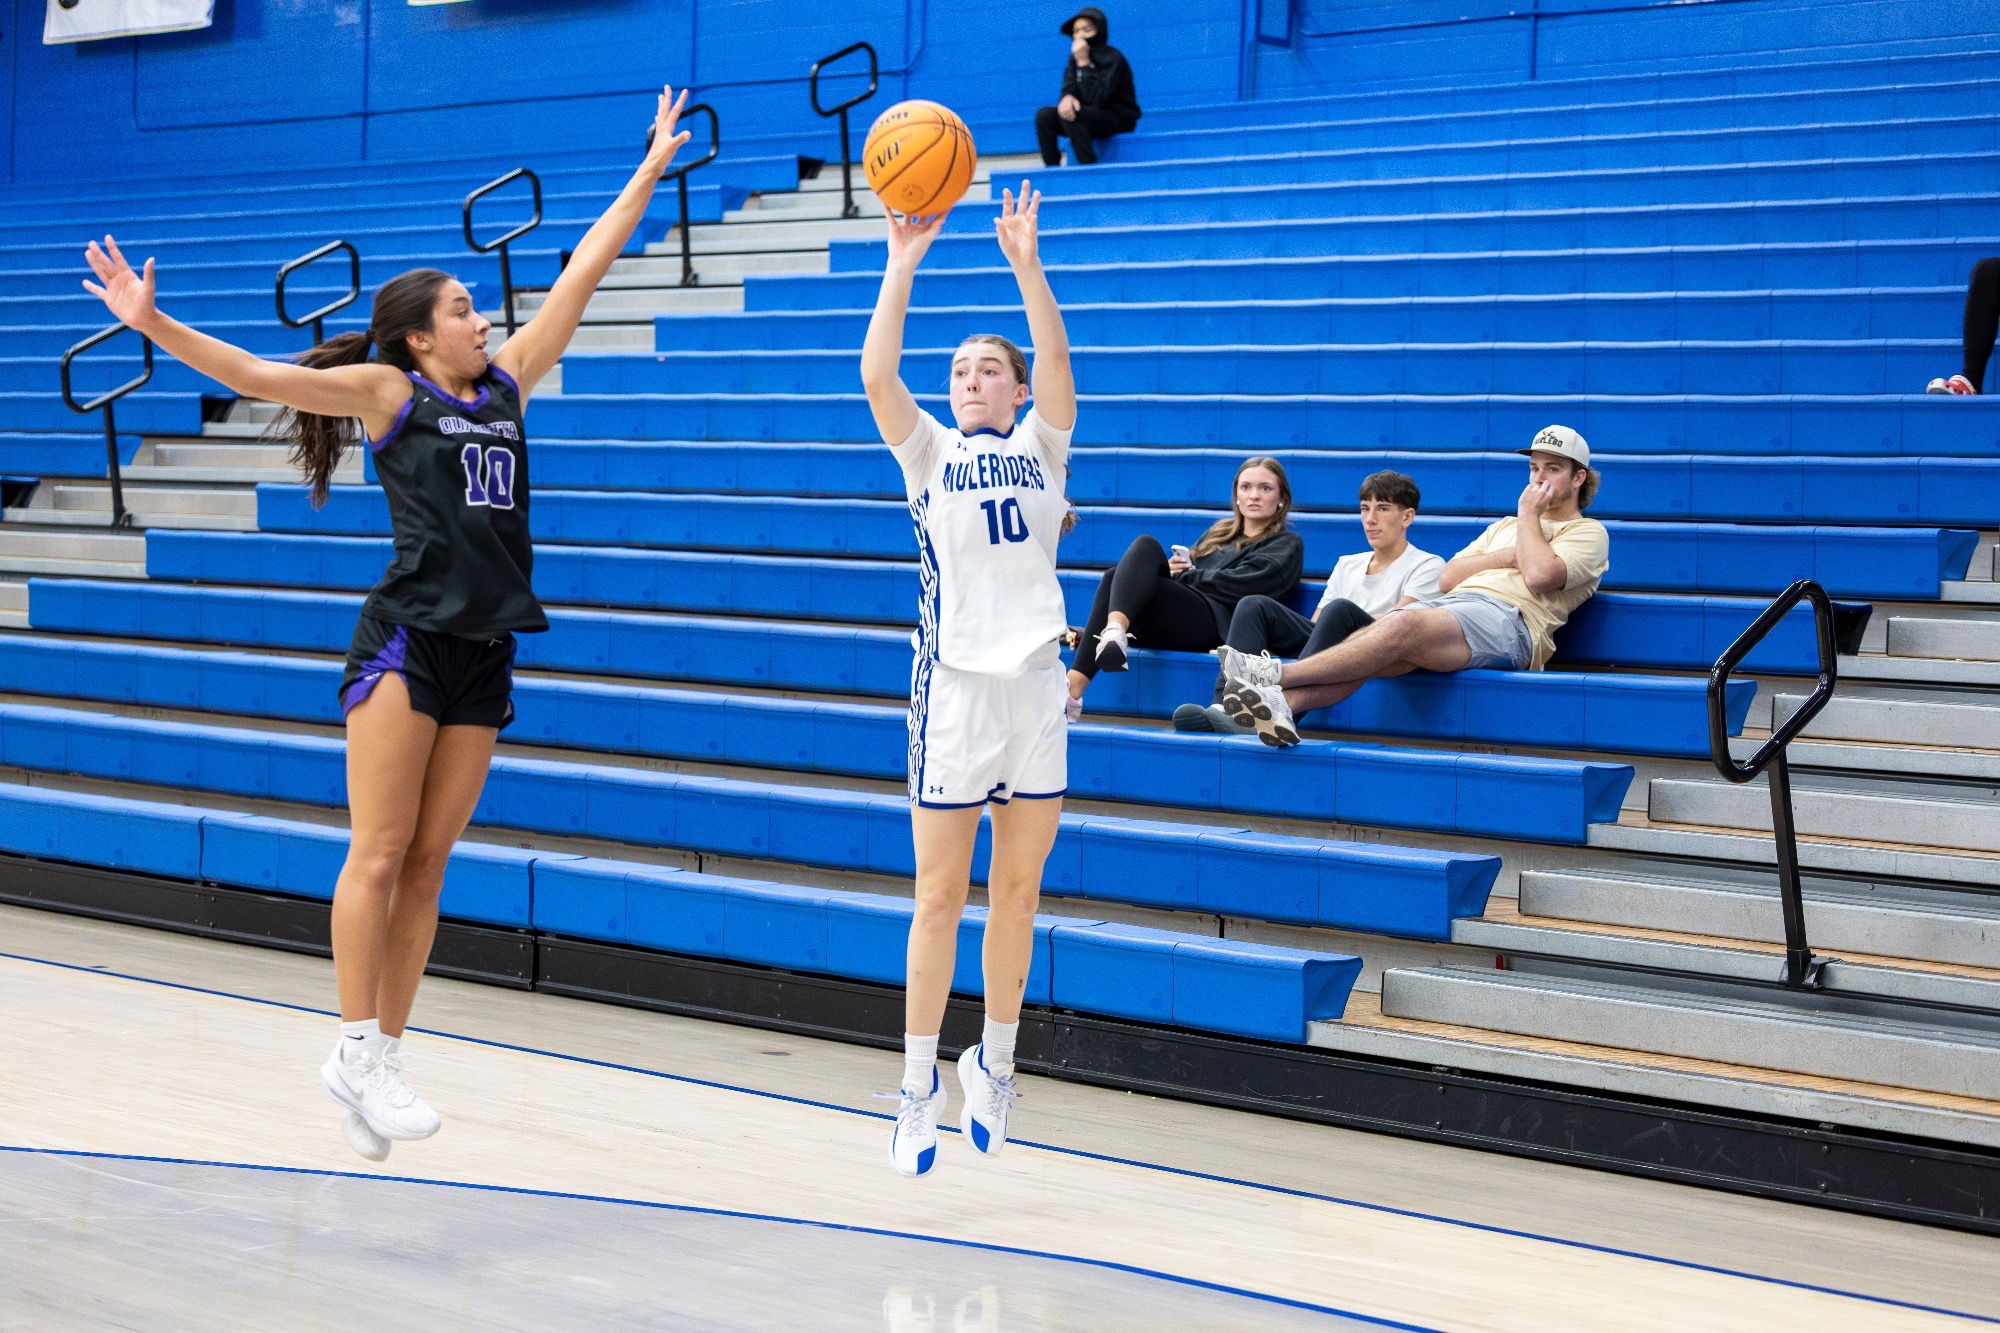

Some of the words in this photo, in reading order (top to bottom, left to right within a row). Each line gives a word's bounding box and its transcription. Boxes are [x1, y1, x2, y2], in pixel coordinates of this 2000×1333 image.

[438, 416, 519, 441] OUATA
[461, 443, 515, 510] 10
[942, 453, 1045, 493] MULERIDERS
[979, 497, 1030, 545] 10
